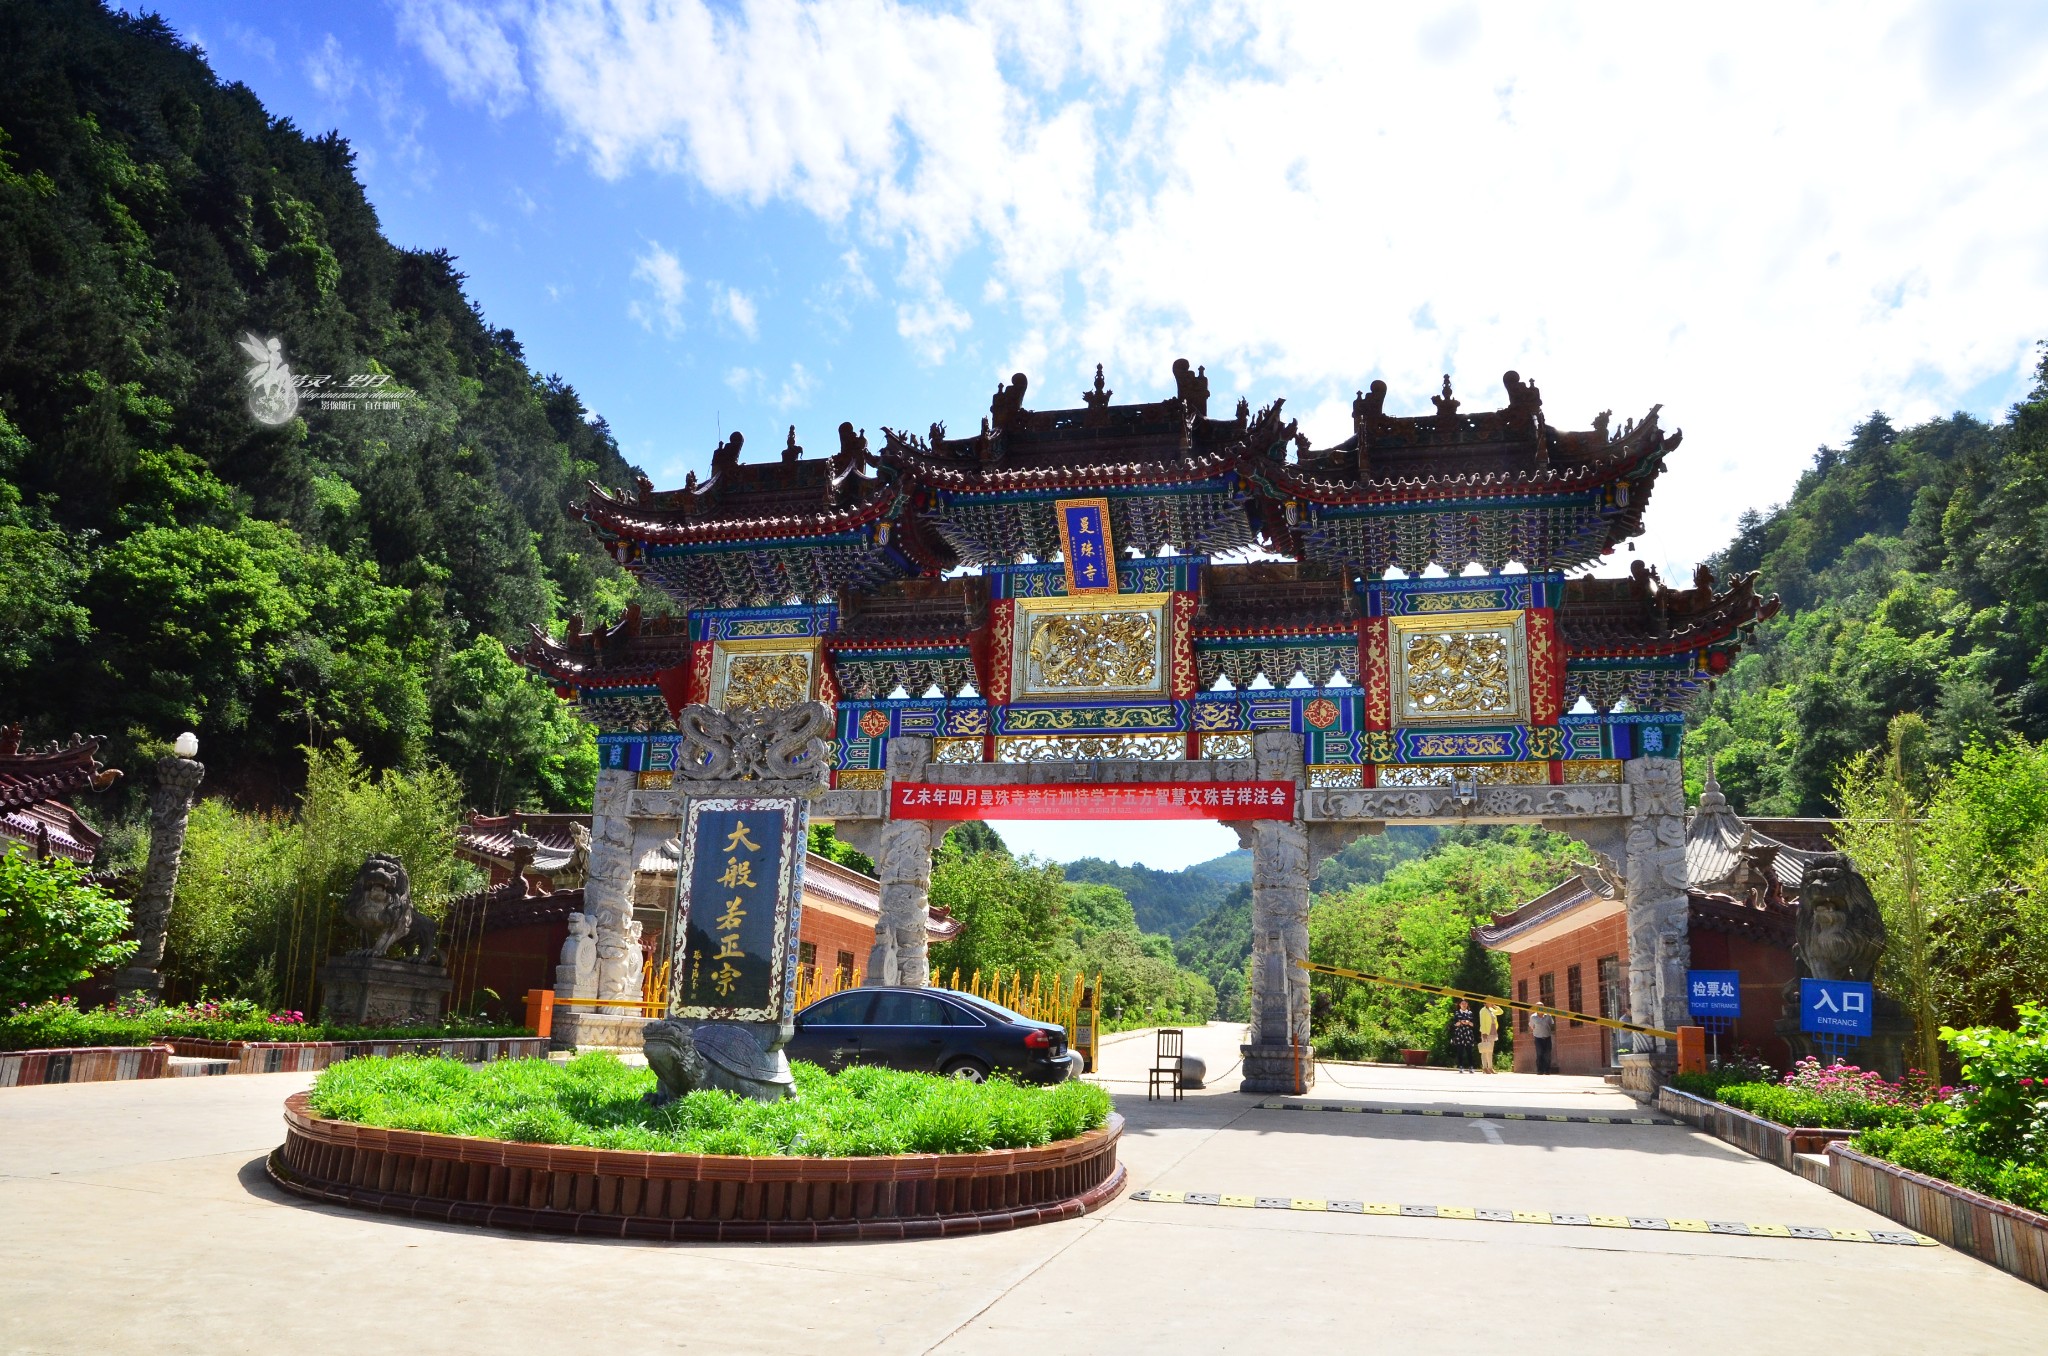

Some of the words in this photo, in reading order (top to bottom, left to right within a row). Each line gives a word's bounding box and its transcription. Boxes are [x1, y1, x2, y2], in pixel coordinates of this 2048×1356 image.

[1079, 516, 1097, 581] 曼殊寺
[902, 788, 1286, 807] 乙未年四月曼殊寺举行加持学子五方智慧文殊吉祥法会
[711, 820, 761, 997] 大般若正宗
[1693, 981, 1735, 997] 检票处
[1813, 989, 1864, 1013] 入口
[1817, 1016, 1858, 1027] ENTRANCE
